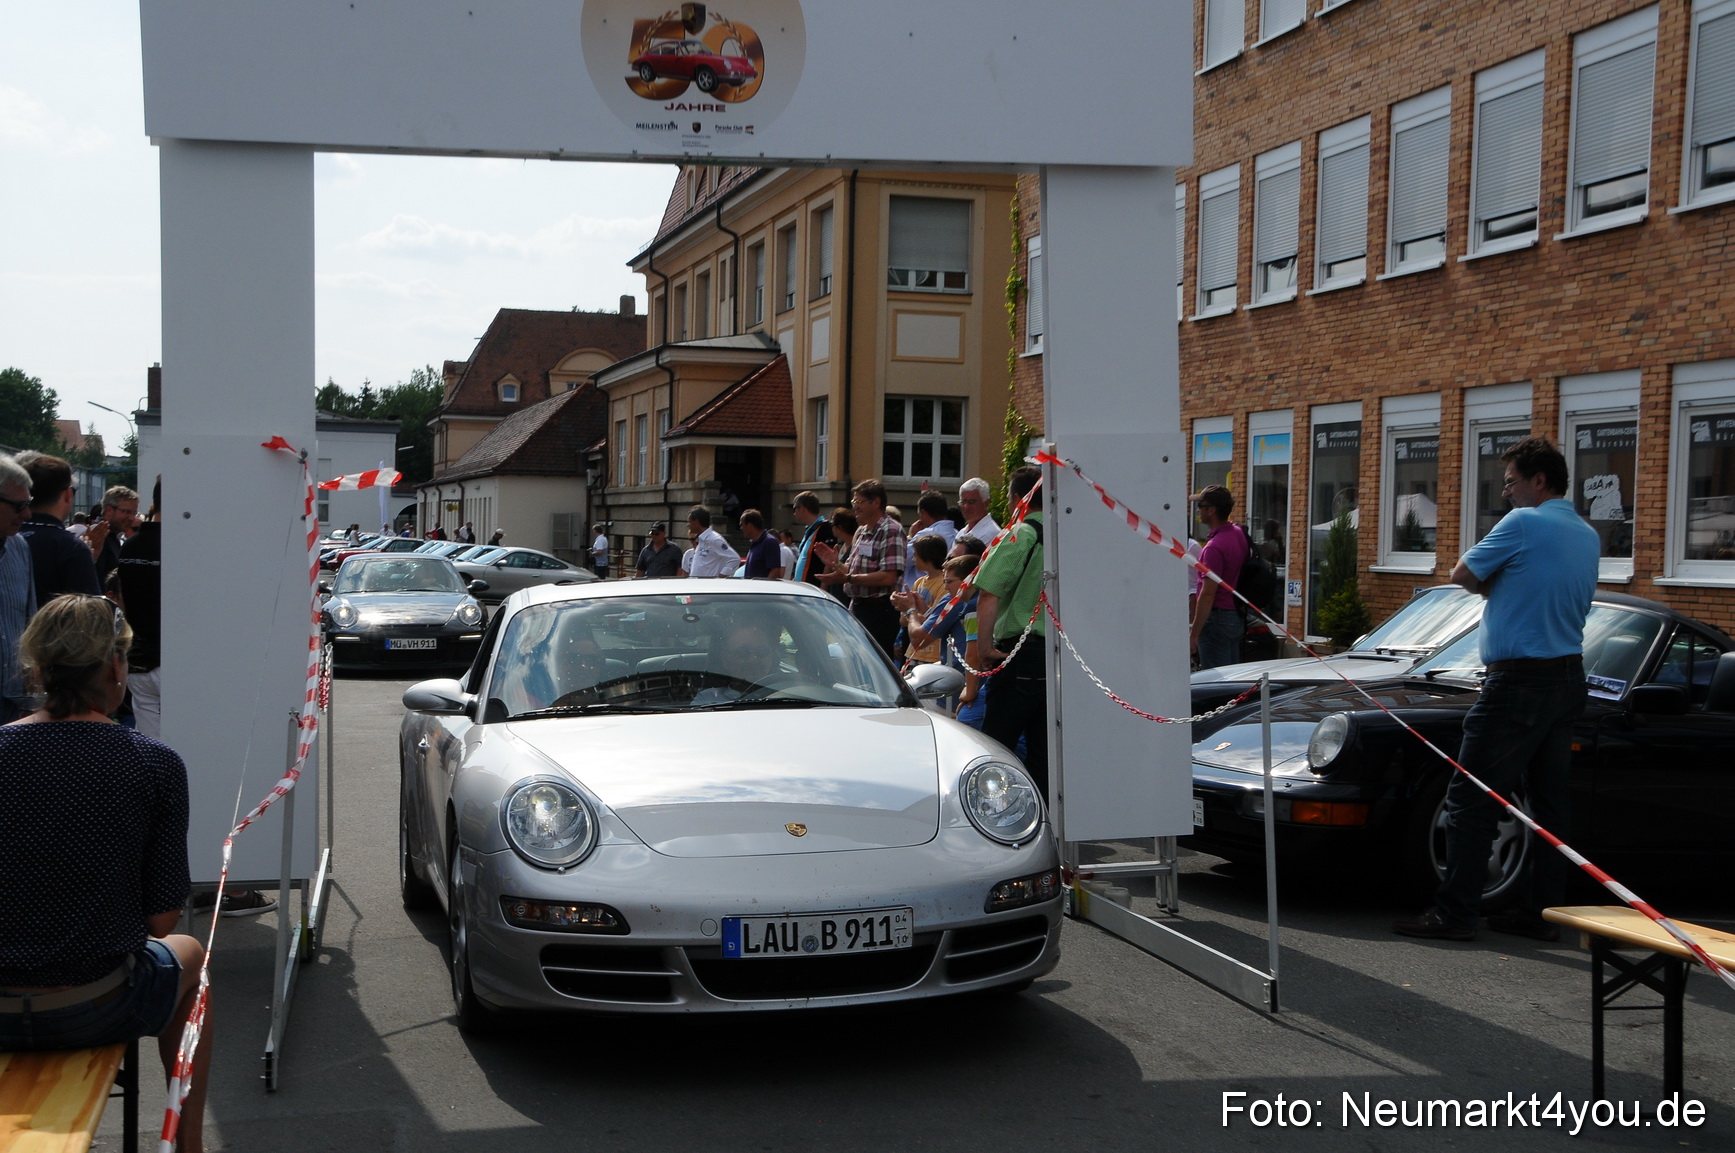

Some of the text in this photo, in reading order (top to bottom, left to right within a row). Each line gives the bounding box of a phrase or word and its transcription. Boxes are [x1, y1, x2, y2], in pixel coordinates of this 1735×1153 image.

[664, 102, 726, 113] JAHRE
[635, 122, 679, 131] MEILENSTEIN
[119, 558, 160, 566] PORSCHE
[390, 640, 436, 648] MÜ VH 911
[895, 914, 907, 923] 04
[743, 915, 894, 954] LAU B 911
[896, 935, 908, 945] 10
